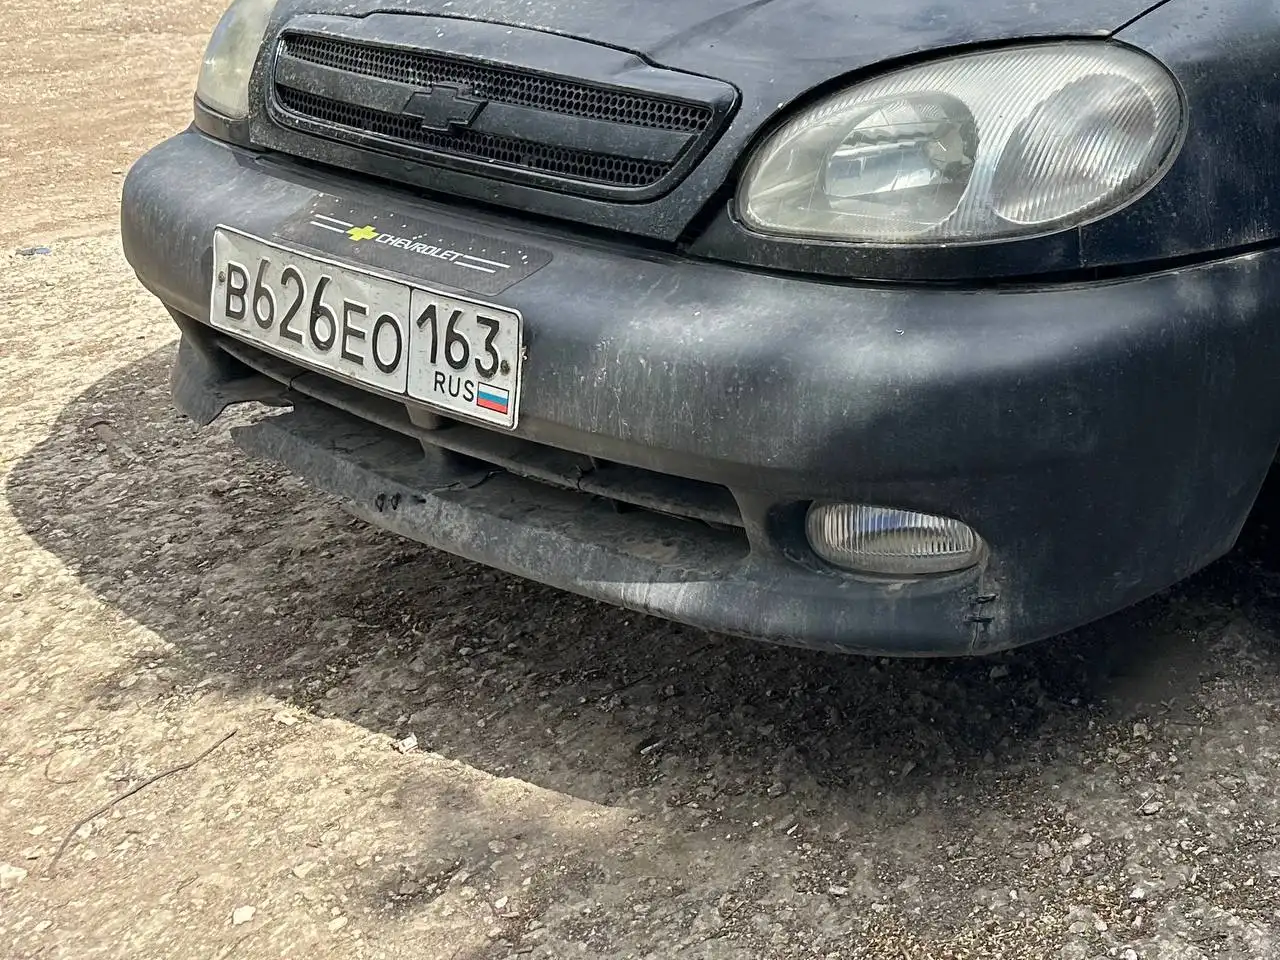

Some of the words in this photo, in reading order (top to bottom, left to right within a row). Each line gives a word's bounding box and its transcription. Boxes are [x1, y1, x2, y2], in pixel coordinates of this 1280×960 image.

[375, 232, 465, 262] CHEVROLET
[416, 304, 500, 380] 163
[433, 370, 475, 402] RUS
